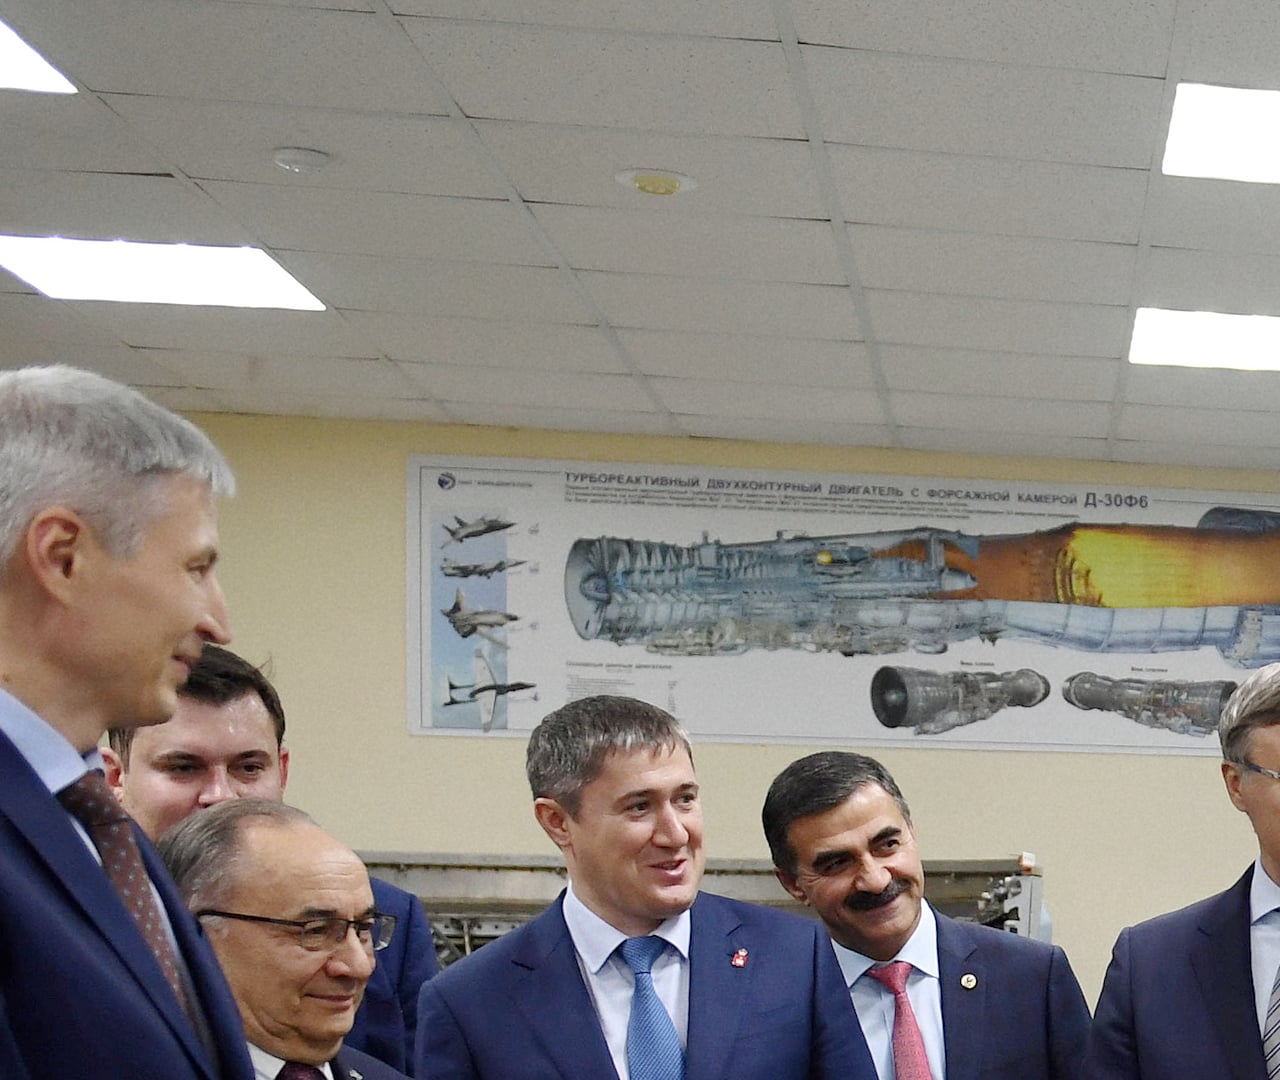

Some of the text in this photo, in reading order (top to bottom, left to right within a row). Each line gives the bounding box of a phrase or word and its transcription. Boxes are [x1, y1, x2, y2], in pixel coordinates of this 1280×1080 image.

[565, 471, 700, 488] ТУРБОРЕАКТИВНЫЙ
[706, 477, 822, 493] ДВУХКОНТУРНЫЙ
[828, 483, 904, 498] ДВИГАТЕЛЬ
[910, 487, 919, 497] С
[927, 488, 1010, 502] ФОРСАЖНОЙ
[1017, 492, 1078, 505] КАМЕРОЙ
[1084, 492, 1149, 509] Д-30Ф6
